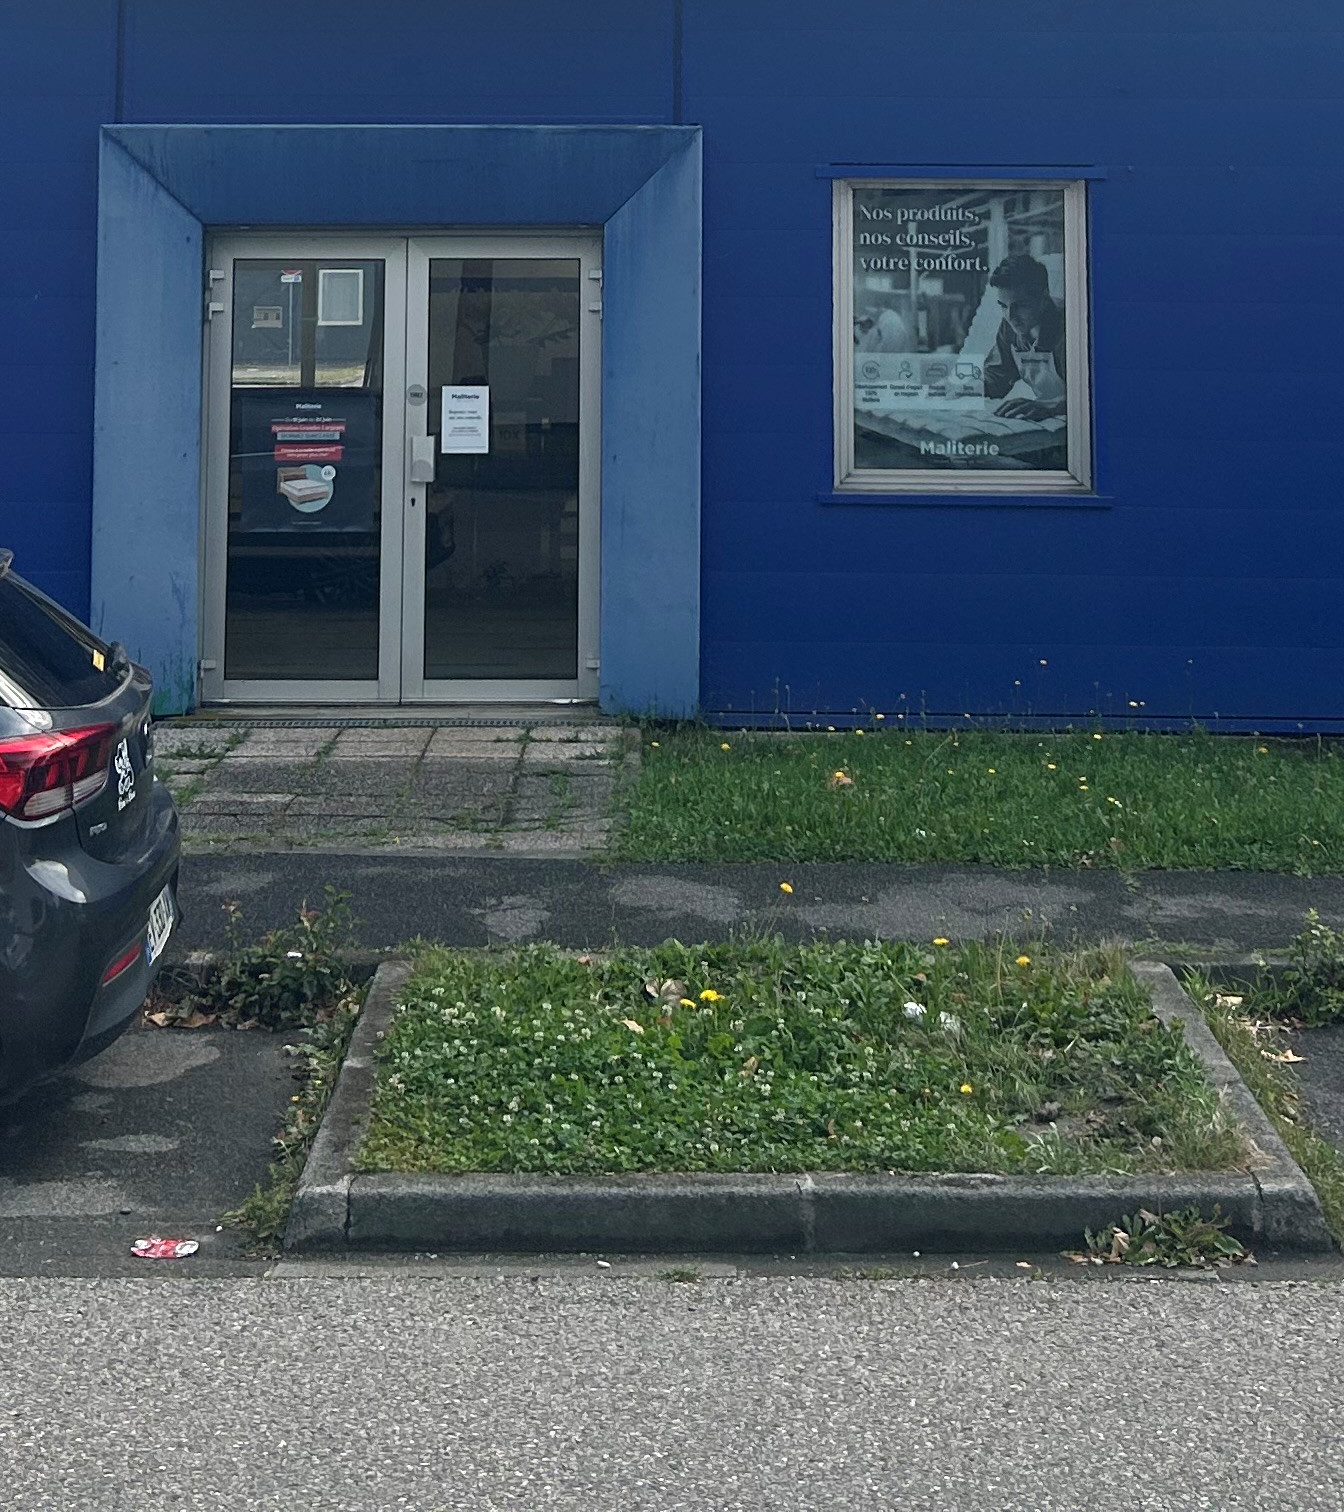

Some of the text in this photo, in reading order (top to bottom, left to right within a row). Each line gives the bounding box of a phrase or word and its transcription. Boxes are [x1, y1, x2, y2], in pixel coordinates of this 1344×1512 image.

[859, 204, 980, 225] Nos produits,
[859, 229, 976, 248] nos conseils,
[859, 253, 988, 272] votre confort.
[919, 440, 1000, 456] Maliterie
